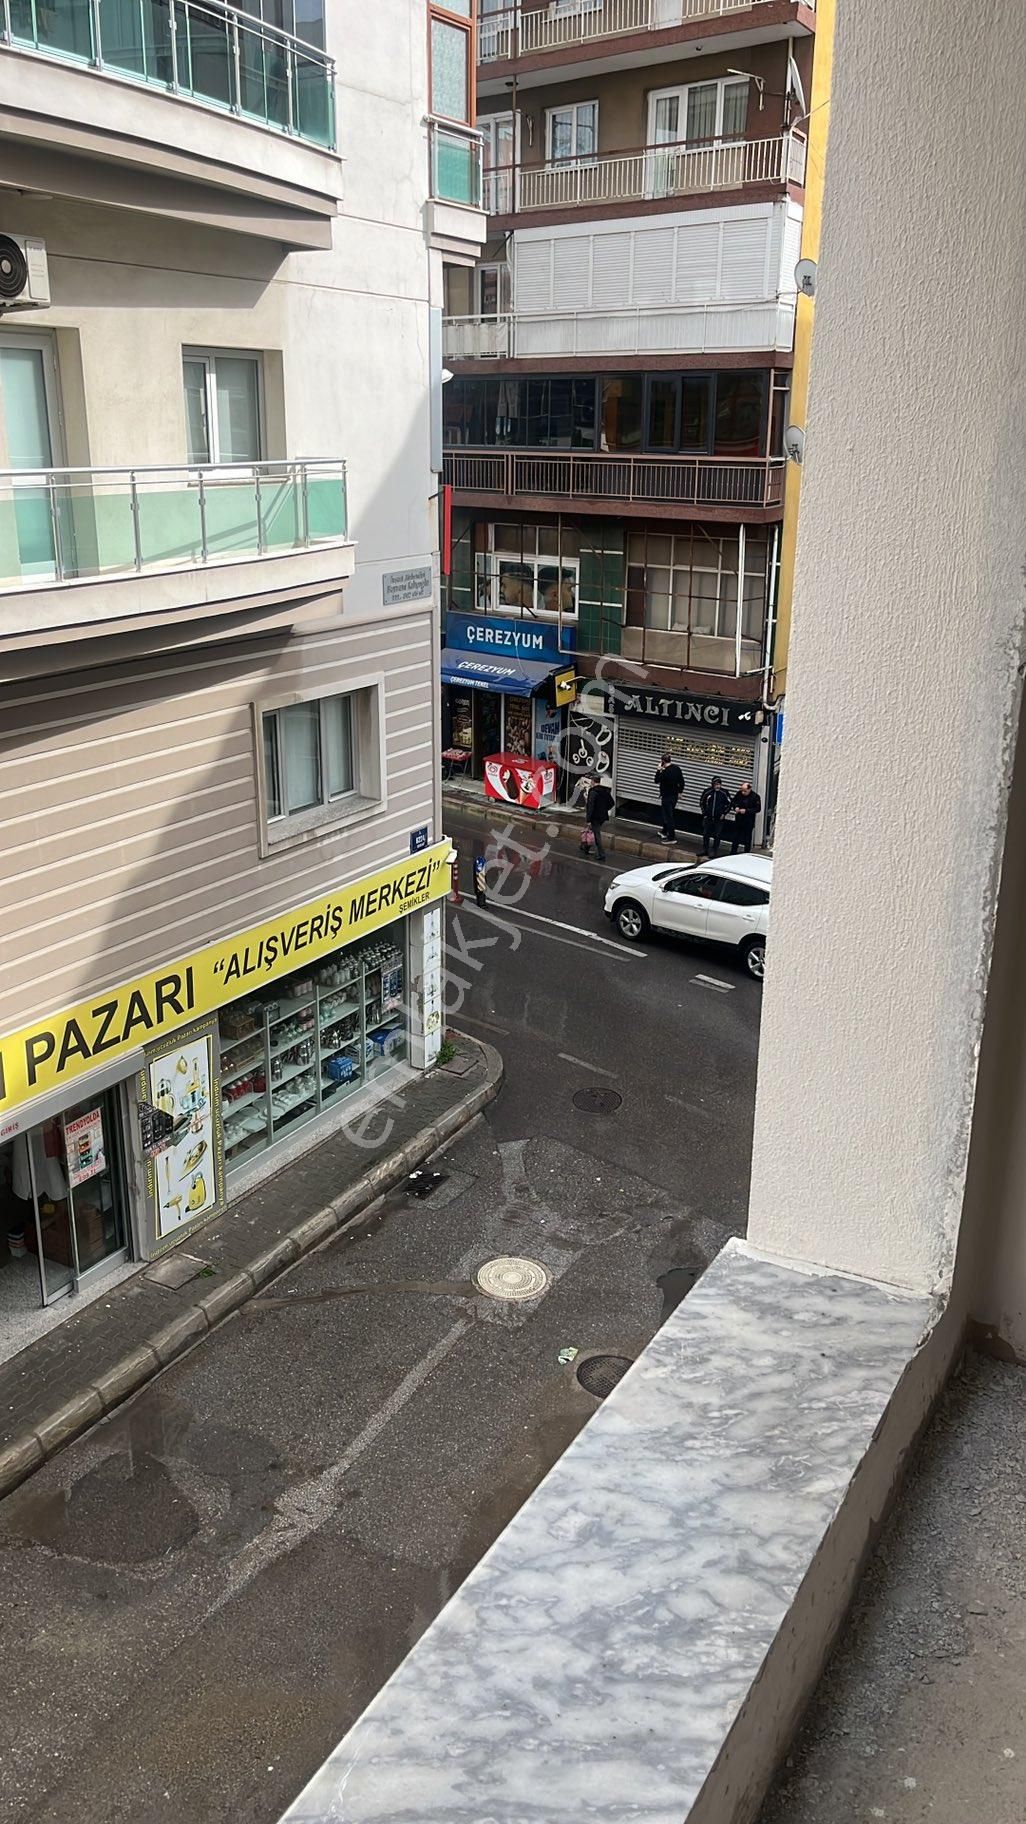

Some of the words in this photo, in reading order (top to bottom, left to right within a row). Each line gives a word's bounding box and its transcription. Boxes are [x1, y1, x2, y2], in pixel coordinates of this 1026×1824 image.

[466, 626, 543, 650] ÇEREZYUM
[457, 661, 516, 676] ÇEREZYUM
[624, 694, 730, 727] ALTINCI
[398, 891, 430, 915] ŞEMİKLER
[25, 965, 195, 1087] PAZARI
